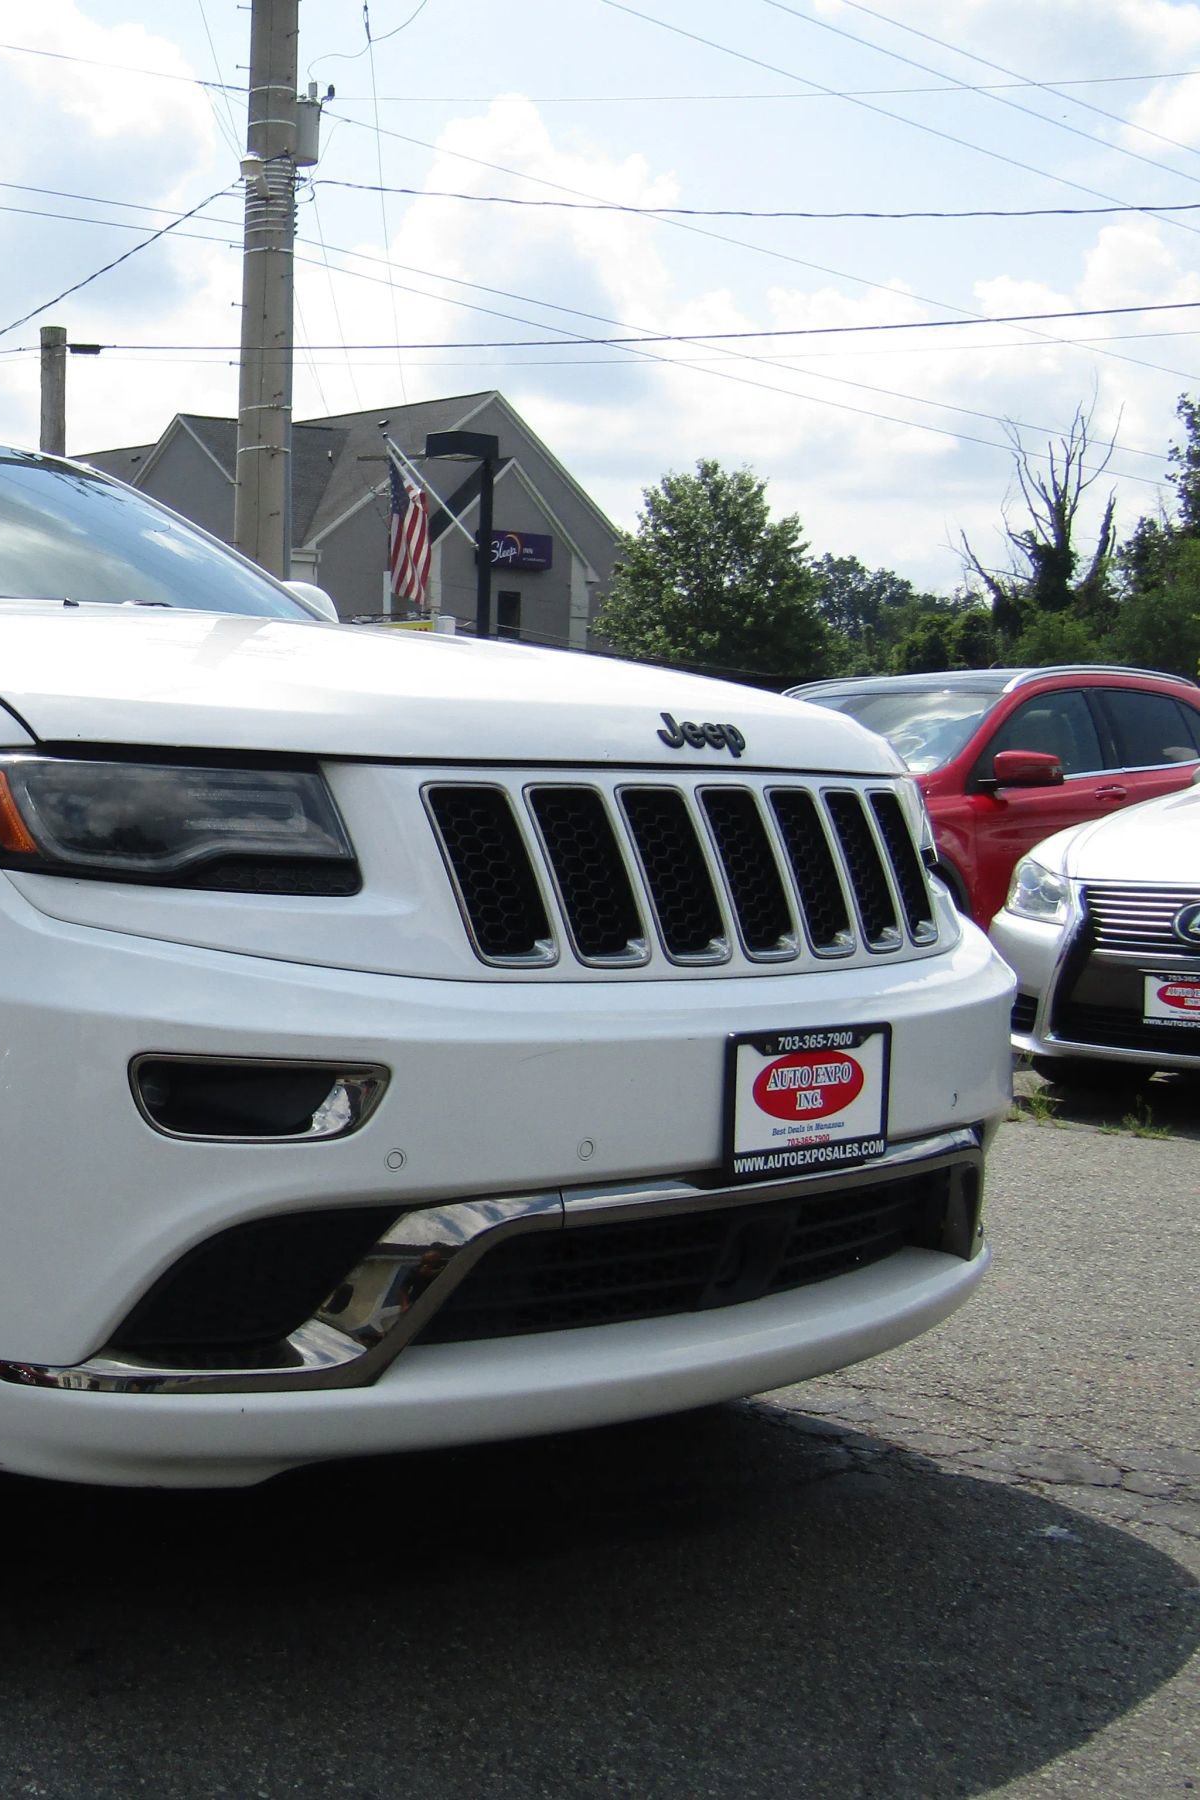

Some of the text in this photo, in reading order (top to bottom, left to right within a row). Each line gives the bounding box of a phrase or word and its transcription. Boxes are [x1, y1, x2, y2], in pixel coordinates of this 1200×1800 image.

[490, 540, 517, 563] Sleep
[656, 712, 746, 758] Jeep
[778, 1031, 853, 1051] 703-365-7900
[767, 1062, 852, 1091] AUTO EXPO
[796, 1090, 823, 1110] INC.
[772, 1127, 786, 1136] Best
[787, 1125, 805, 1134] Deals
[806, 1123, 814, 1132] in
[787, 1133, 830, 1147] 703-365-7900
[734, 1139, 885, 1173] WWW.AUTOEXPOSALES.COM
